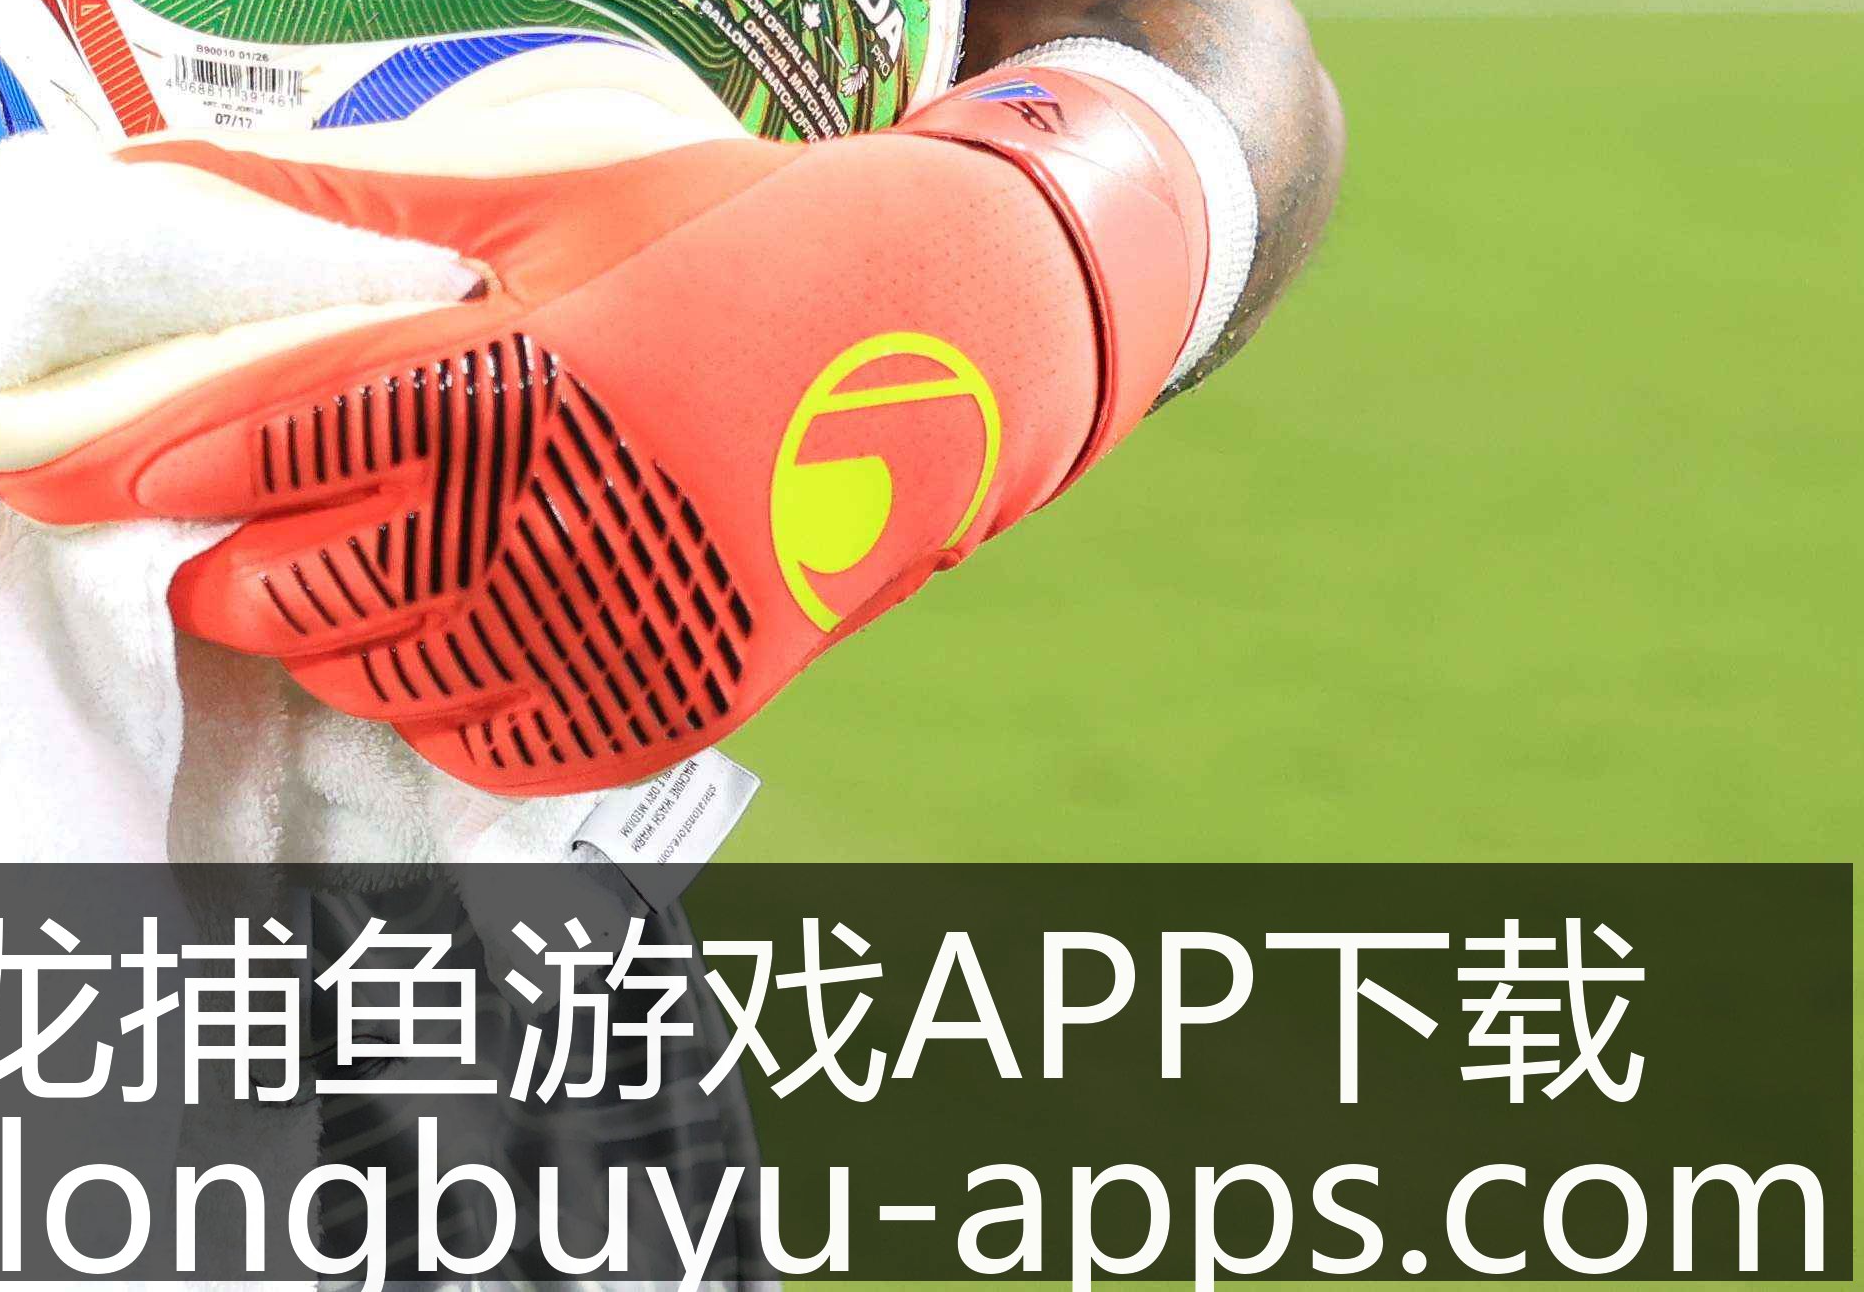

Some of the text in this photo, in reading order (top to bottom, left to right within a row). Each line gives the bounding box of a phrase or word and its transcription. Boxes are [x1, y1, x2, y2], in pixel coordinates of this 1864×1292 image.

[700, 0, 753, 54] BALLON
[748, 49, 767, 72] DE
[762, 65, 798, 114] MATCH
[743, 19, 789, 78] OFFICIAL
[788, 72, 824, 121] MATCH
[764, 15, 804, 66] OFICIAL
[800, 60, 820, 89] DEL
[817, 82, 849, 136] PARTIDO
[870, 44, 890, 77] PRO
[631, 825, 654, 853] WARM
[652, 798, 675, 827] WASH
